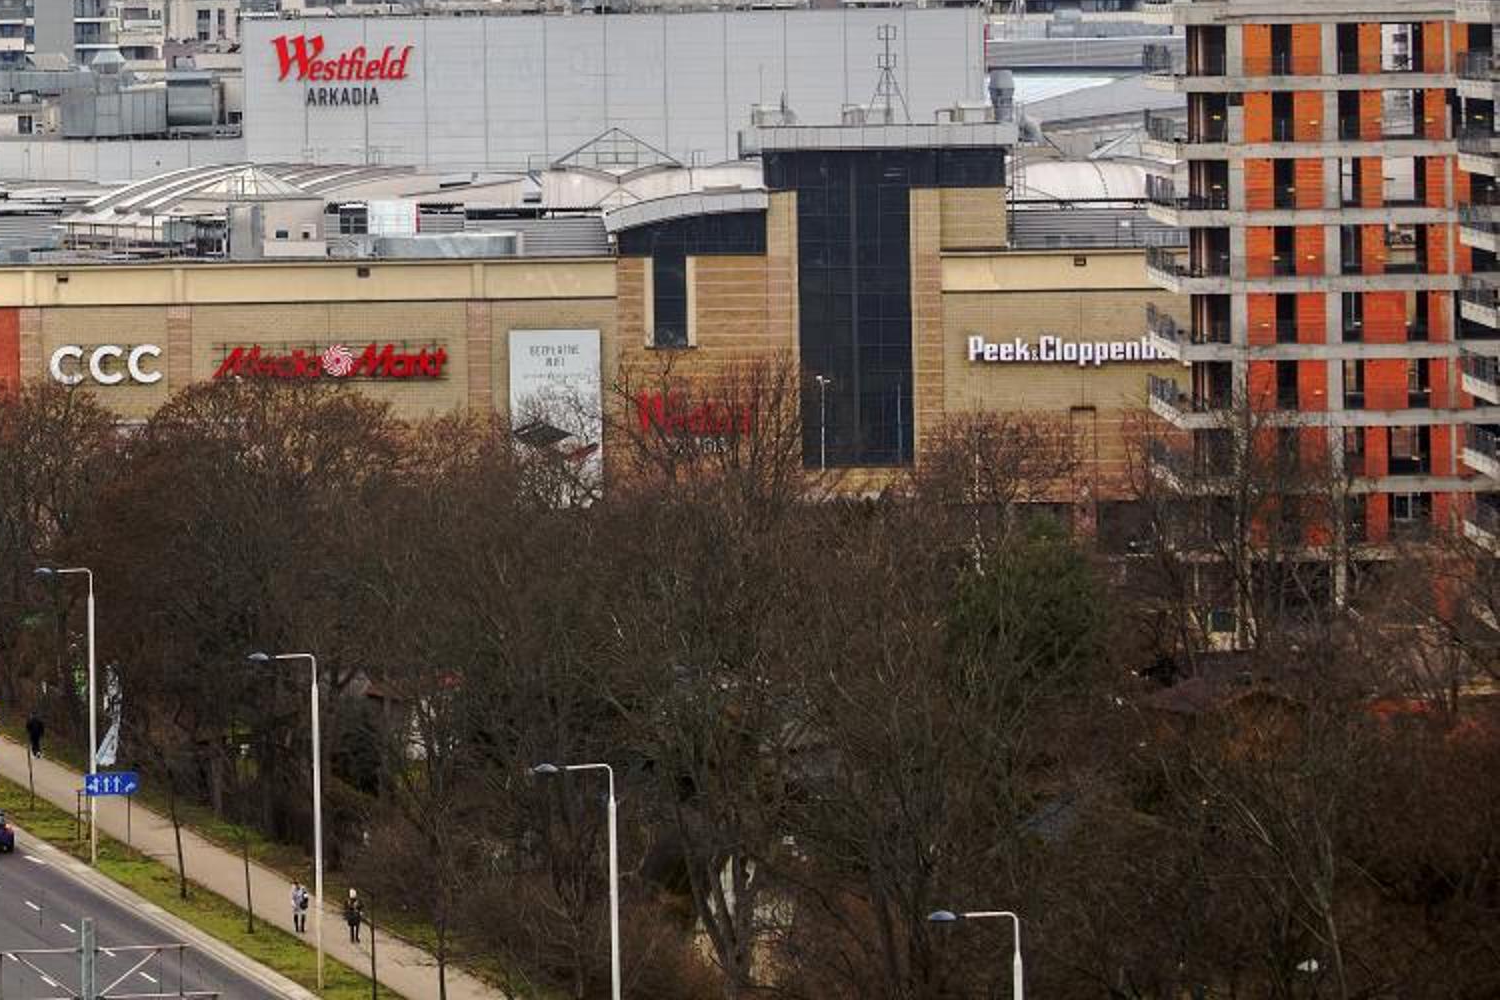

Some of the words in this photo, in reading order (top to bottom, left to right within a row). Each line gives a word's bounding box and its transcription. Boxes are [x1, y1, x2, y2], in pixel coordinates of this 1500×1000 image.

[270, 34, 414, 82] Westfield
[307, 87, 379, 106] ARKADIA
[51, 344, 163, 385] CCC
[350, 343, 448, 378] Markt
